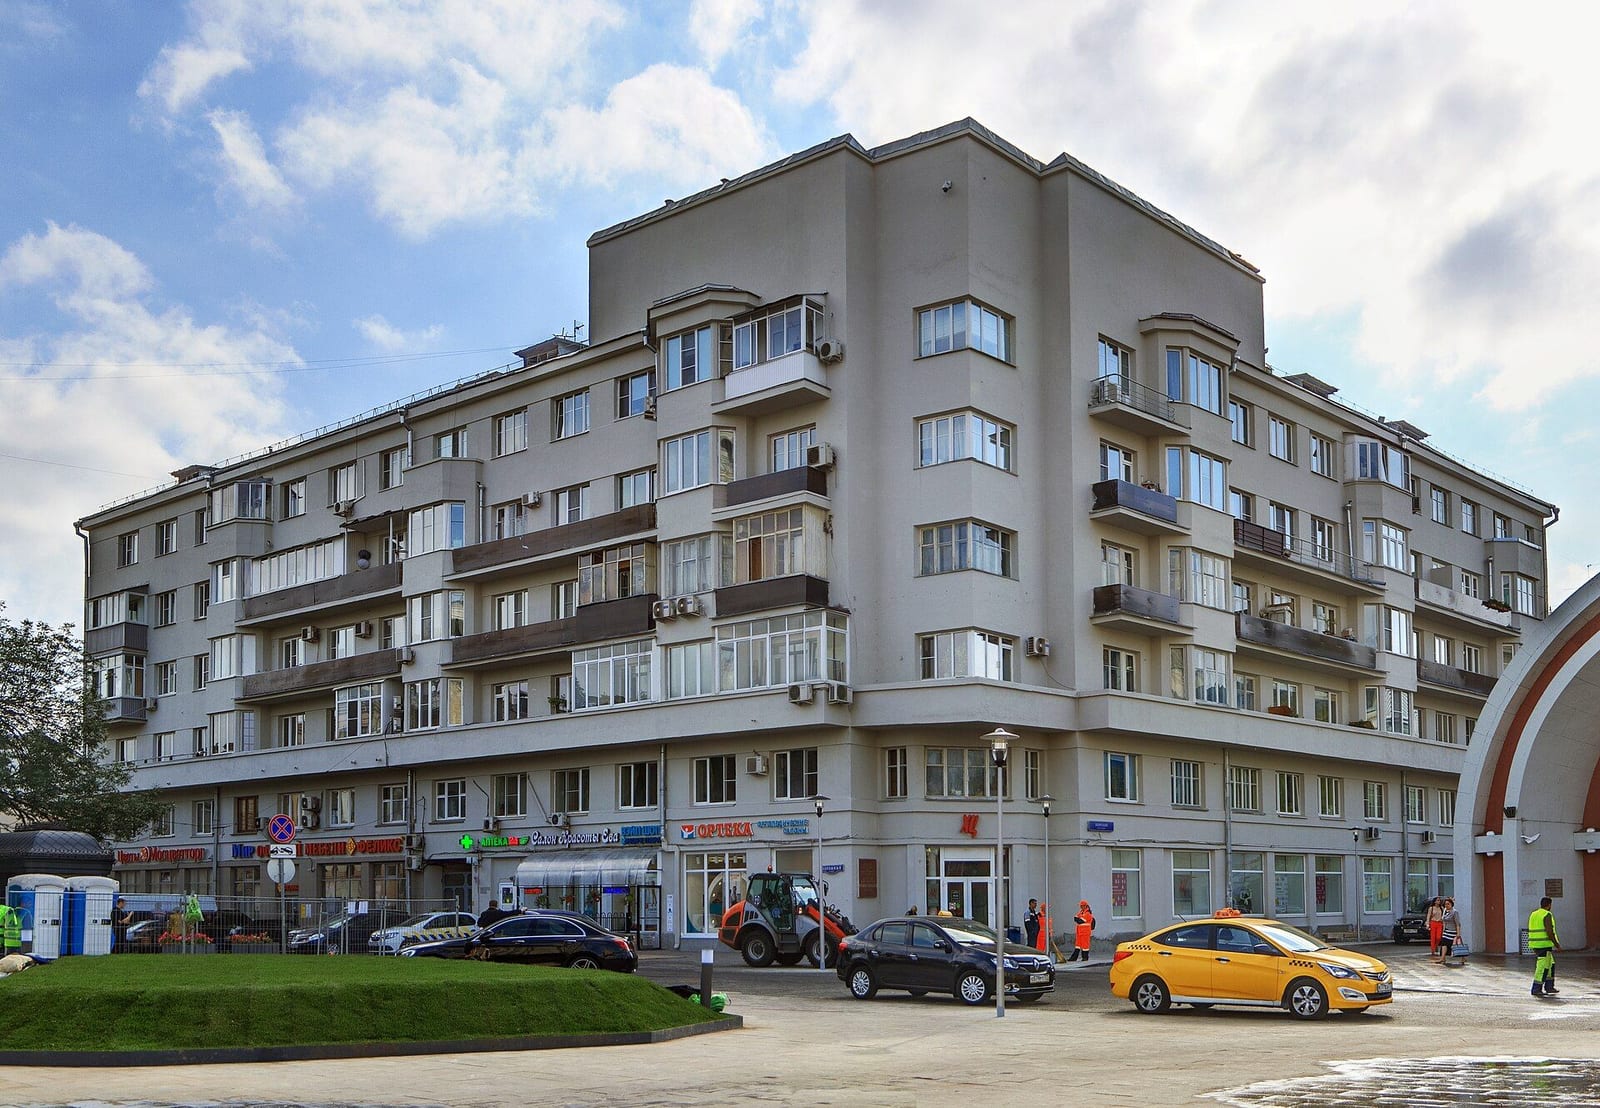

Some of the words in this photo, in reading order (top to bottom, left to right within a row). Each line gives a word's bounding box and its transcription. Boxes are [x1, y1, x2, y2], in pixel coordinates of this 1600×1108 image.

[531, 831, 558, 845] Салон
[558, 829, 600, 848] Красоты
[602, 828, 619, 843] Ева
[697, 822, 753, 838] ОРТЕКА
[356, 837, 405, 854] ФЕЛИКС
[481, 836, 509, 847] АПТЕКА
